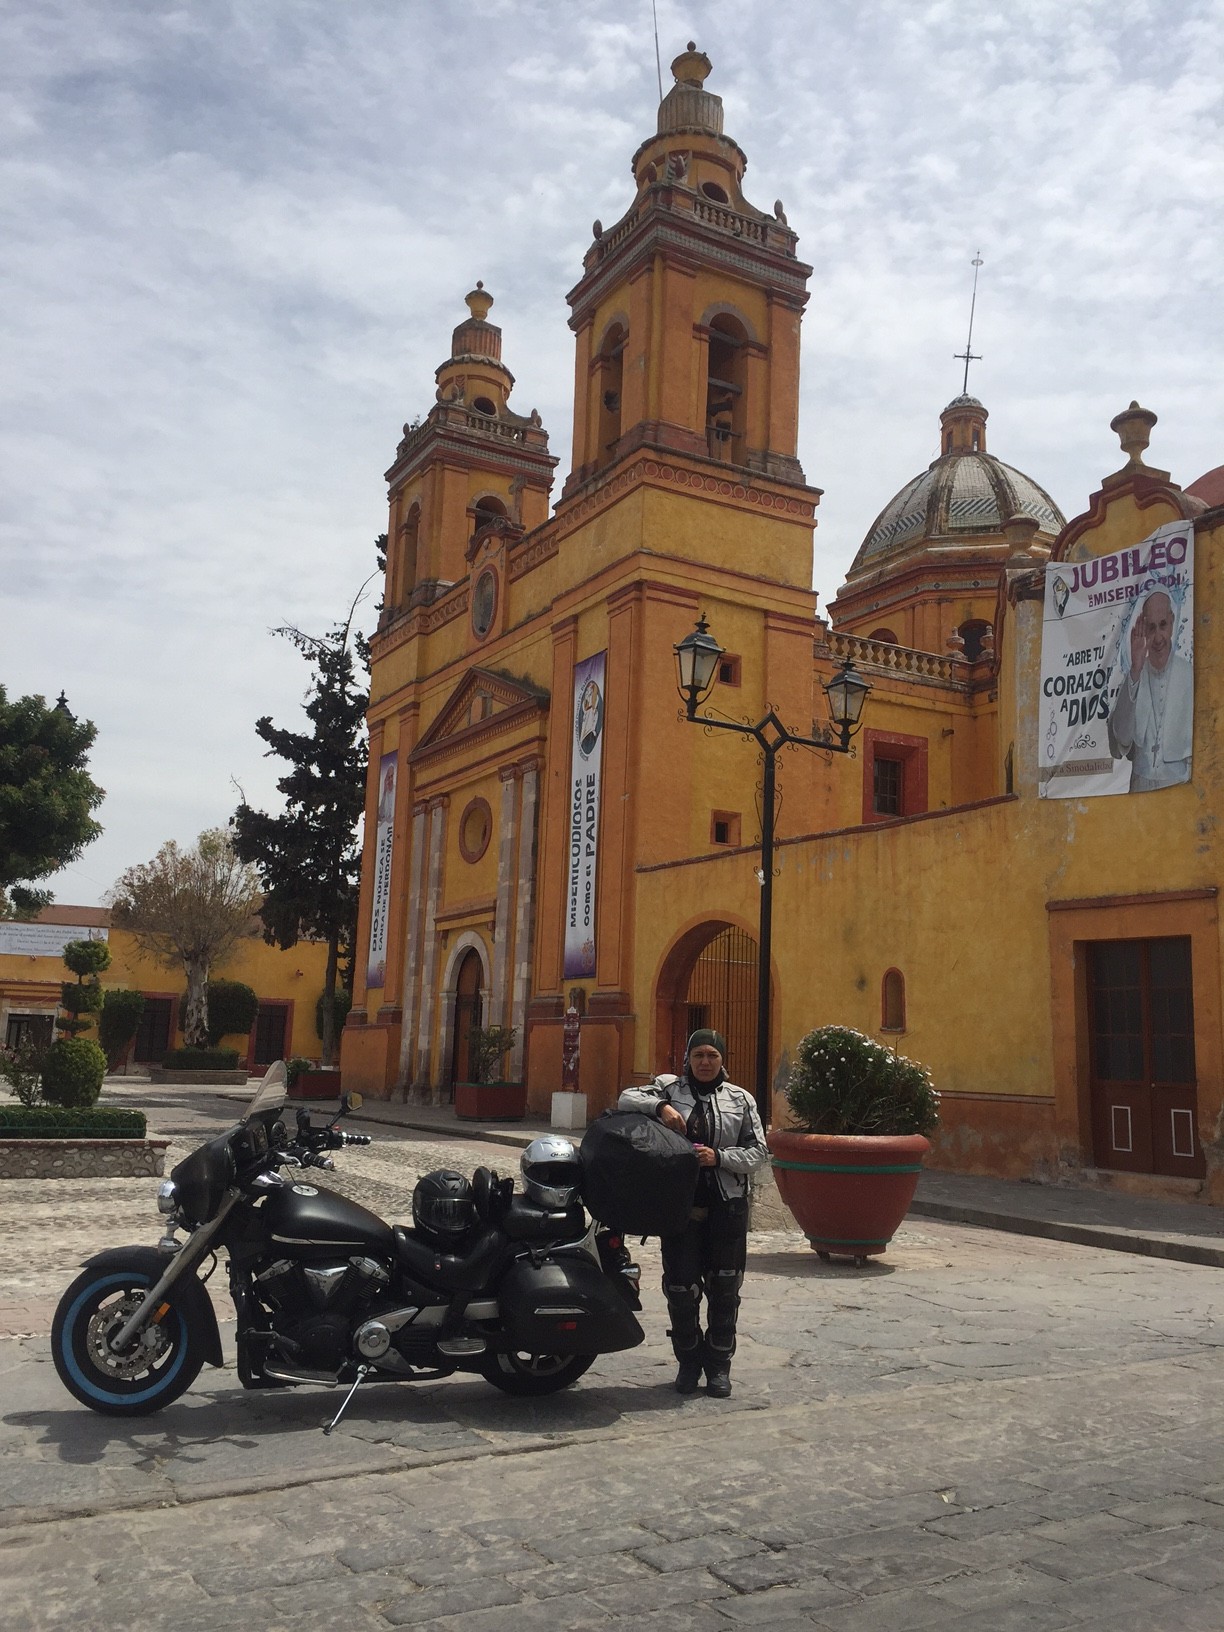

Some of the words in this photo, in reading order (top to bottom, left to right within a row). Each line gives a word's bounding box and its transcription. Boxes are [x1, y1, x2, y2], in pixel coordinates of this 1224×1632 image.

[1070, 537, 1188, 593] JUBILEO
[1093, 645, 1105, 661] TU
[1060, 698, 1068, 712] A
[585, 773, 595, 857] PADRE
[380, 839, 385, 853] SE
[383, 826, 393, 895] PERDONAR
